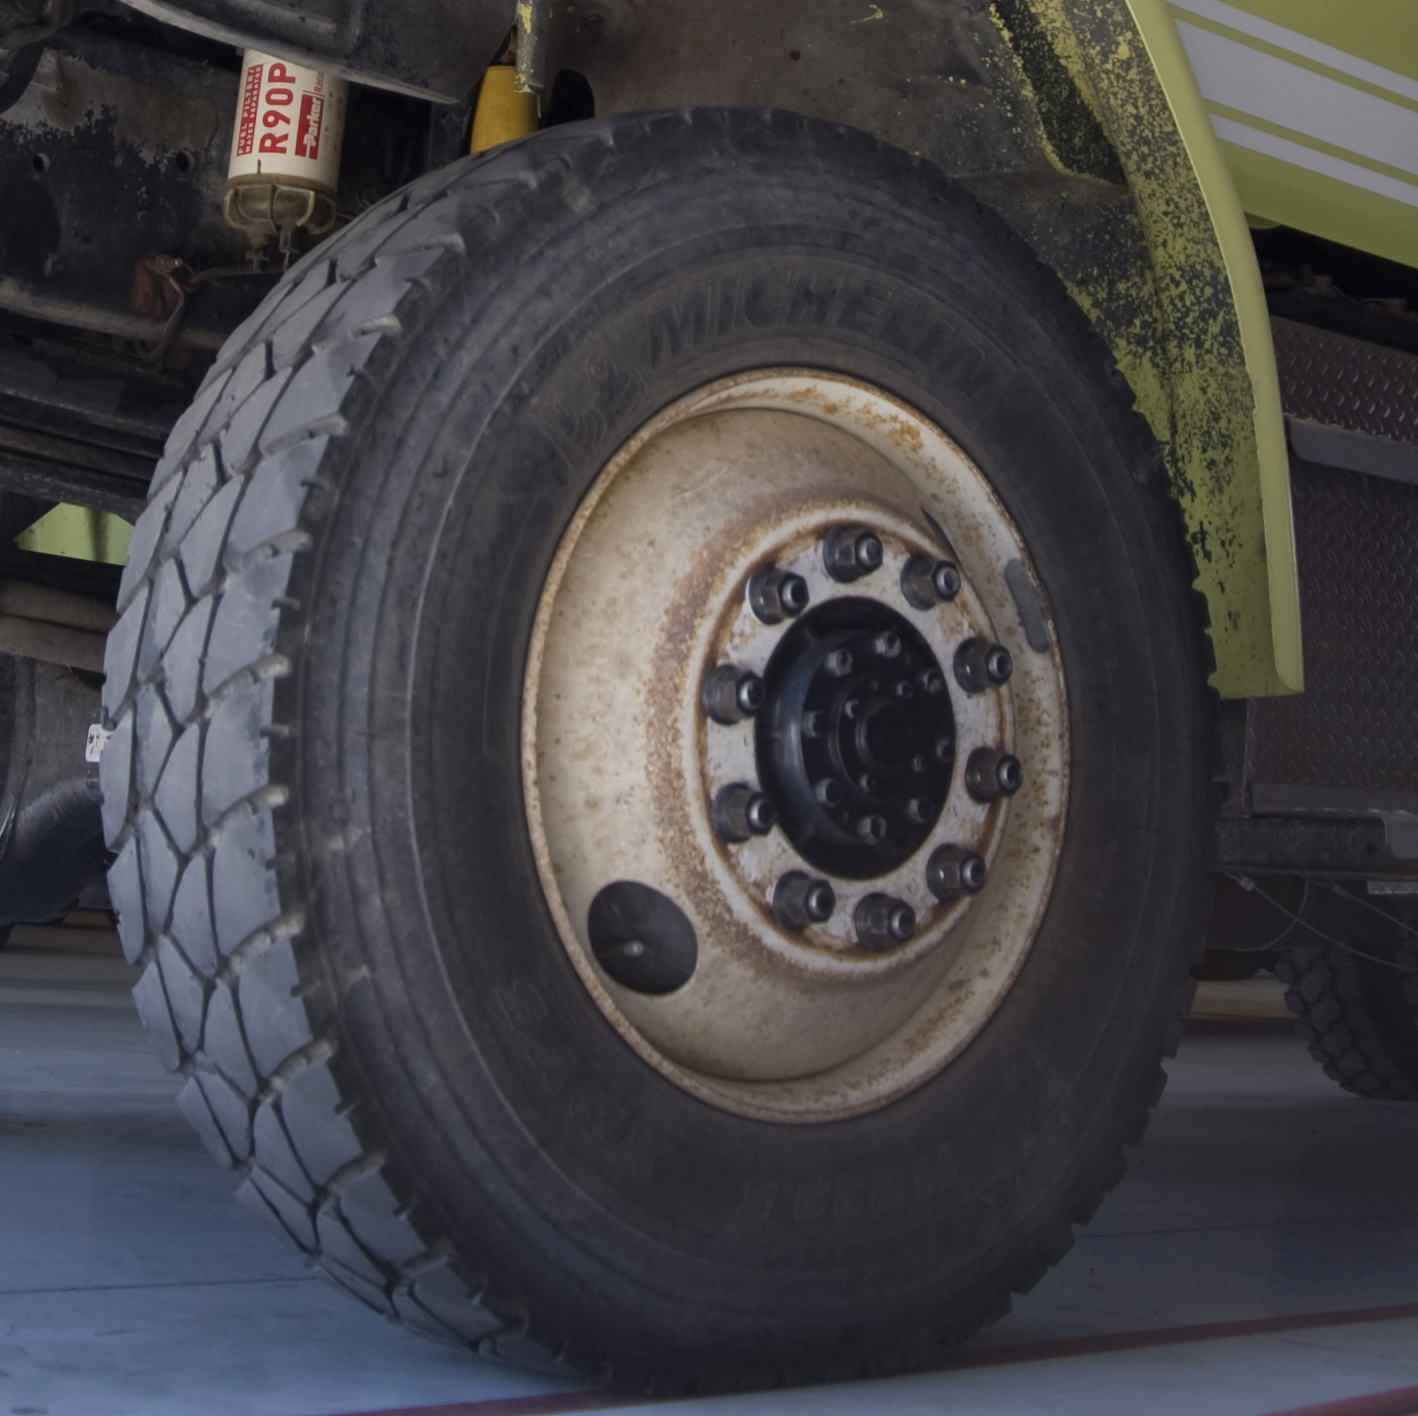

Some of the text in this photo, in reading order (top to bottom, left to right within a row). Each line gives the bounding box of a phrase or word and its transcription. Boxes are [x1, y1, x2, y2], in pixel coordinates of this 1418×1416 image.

[238, 123, 248, 154] FUEL
[245, 66, 261, 153] WATER SEPARATOR
[258, 62, 296, 154] R90P
[302, 96, 322, 147] Parker
[647, 267, 1009, 401] MICHELIN
